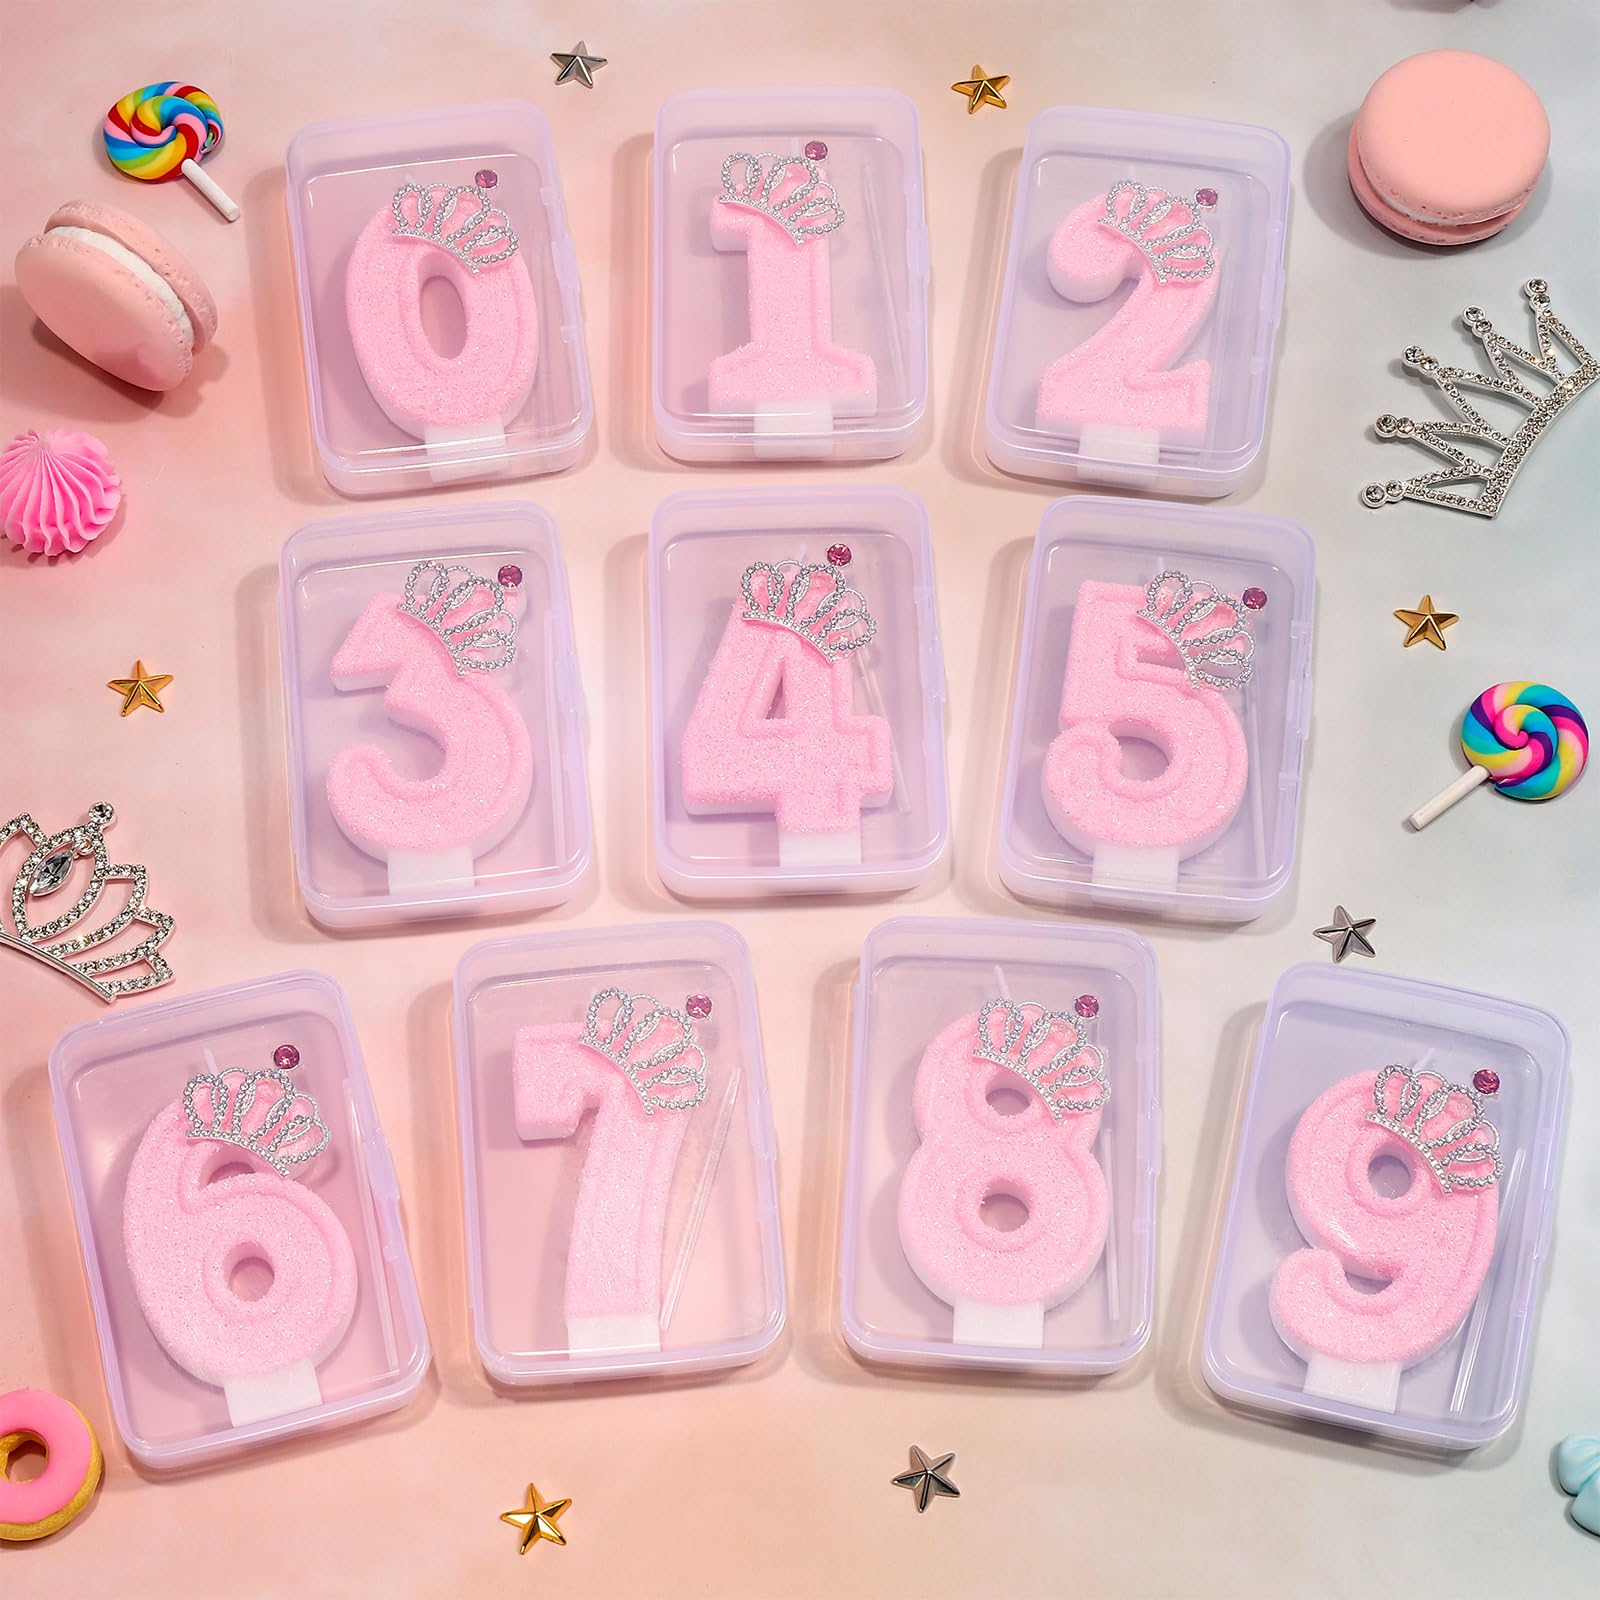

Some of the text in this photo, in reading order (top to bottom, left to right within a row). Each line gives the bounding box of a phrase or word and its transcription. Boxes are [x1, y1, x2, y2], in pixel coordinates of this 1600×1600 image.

[346, 190, 537, 436] 0
[709, 167, 878, 415] 1
[1036, 192, 1219, 433] 2
[328, 585, 534, 856] 3
[683, 571, 894, 833] 4
[1042, 581, 1248, 857] 5
[125, 1088, 358, 1387] 6
[515, 1018, 702, 1320] 7
[898, 1006, 1109, 1310] 8
[1268, 1068, 1500, 1363] 9
